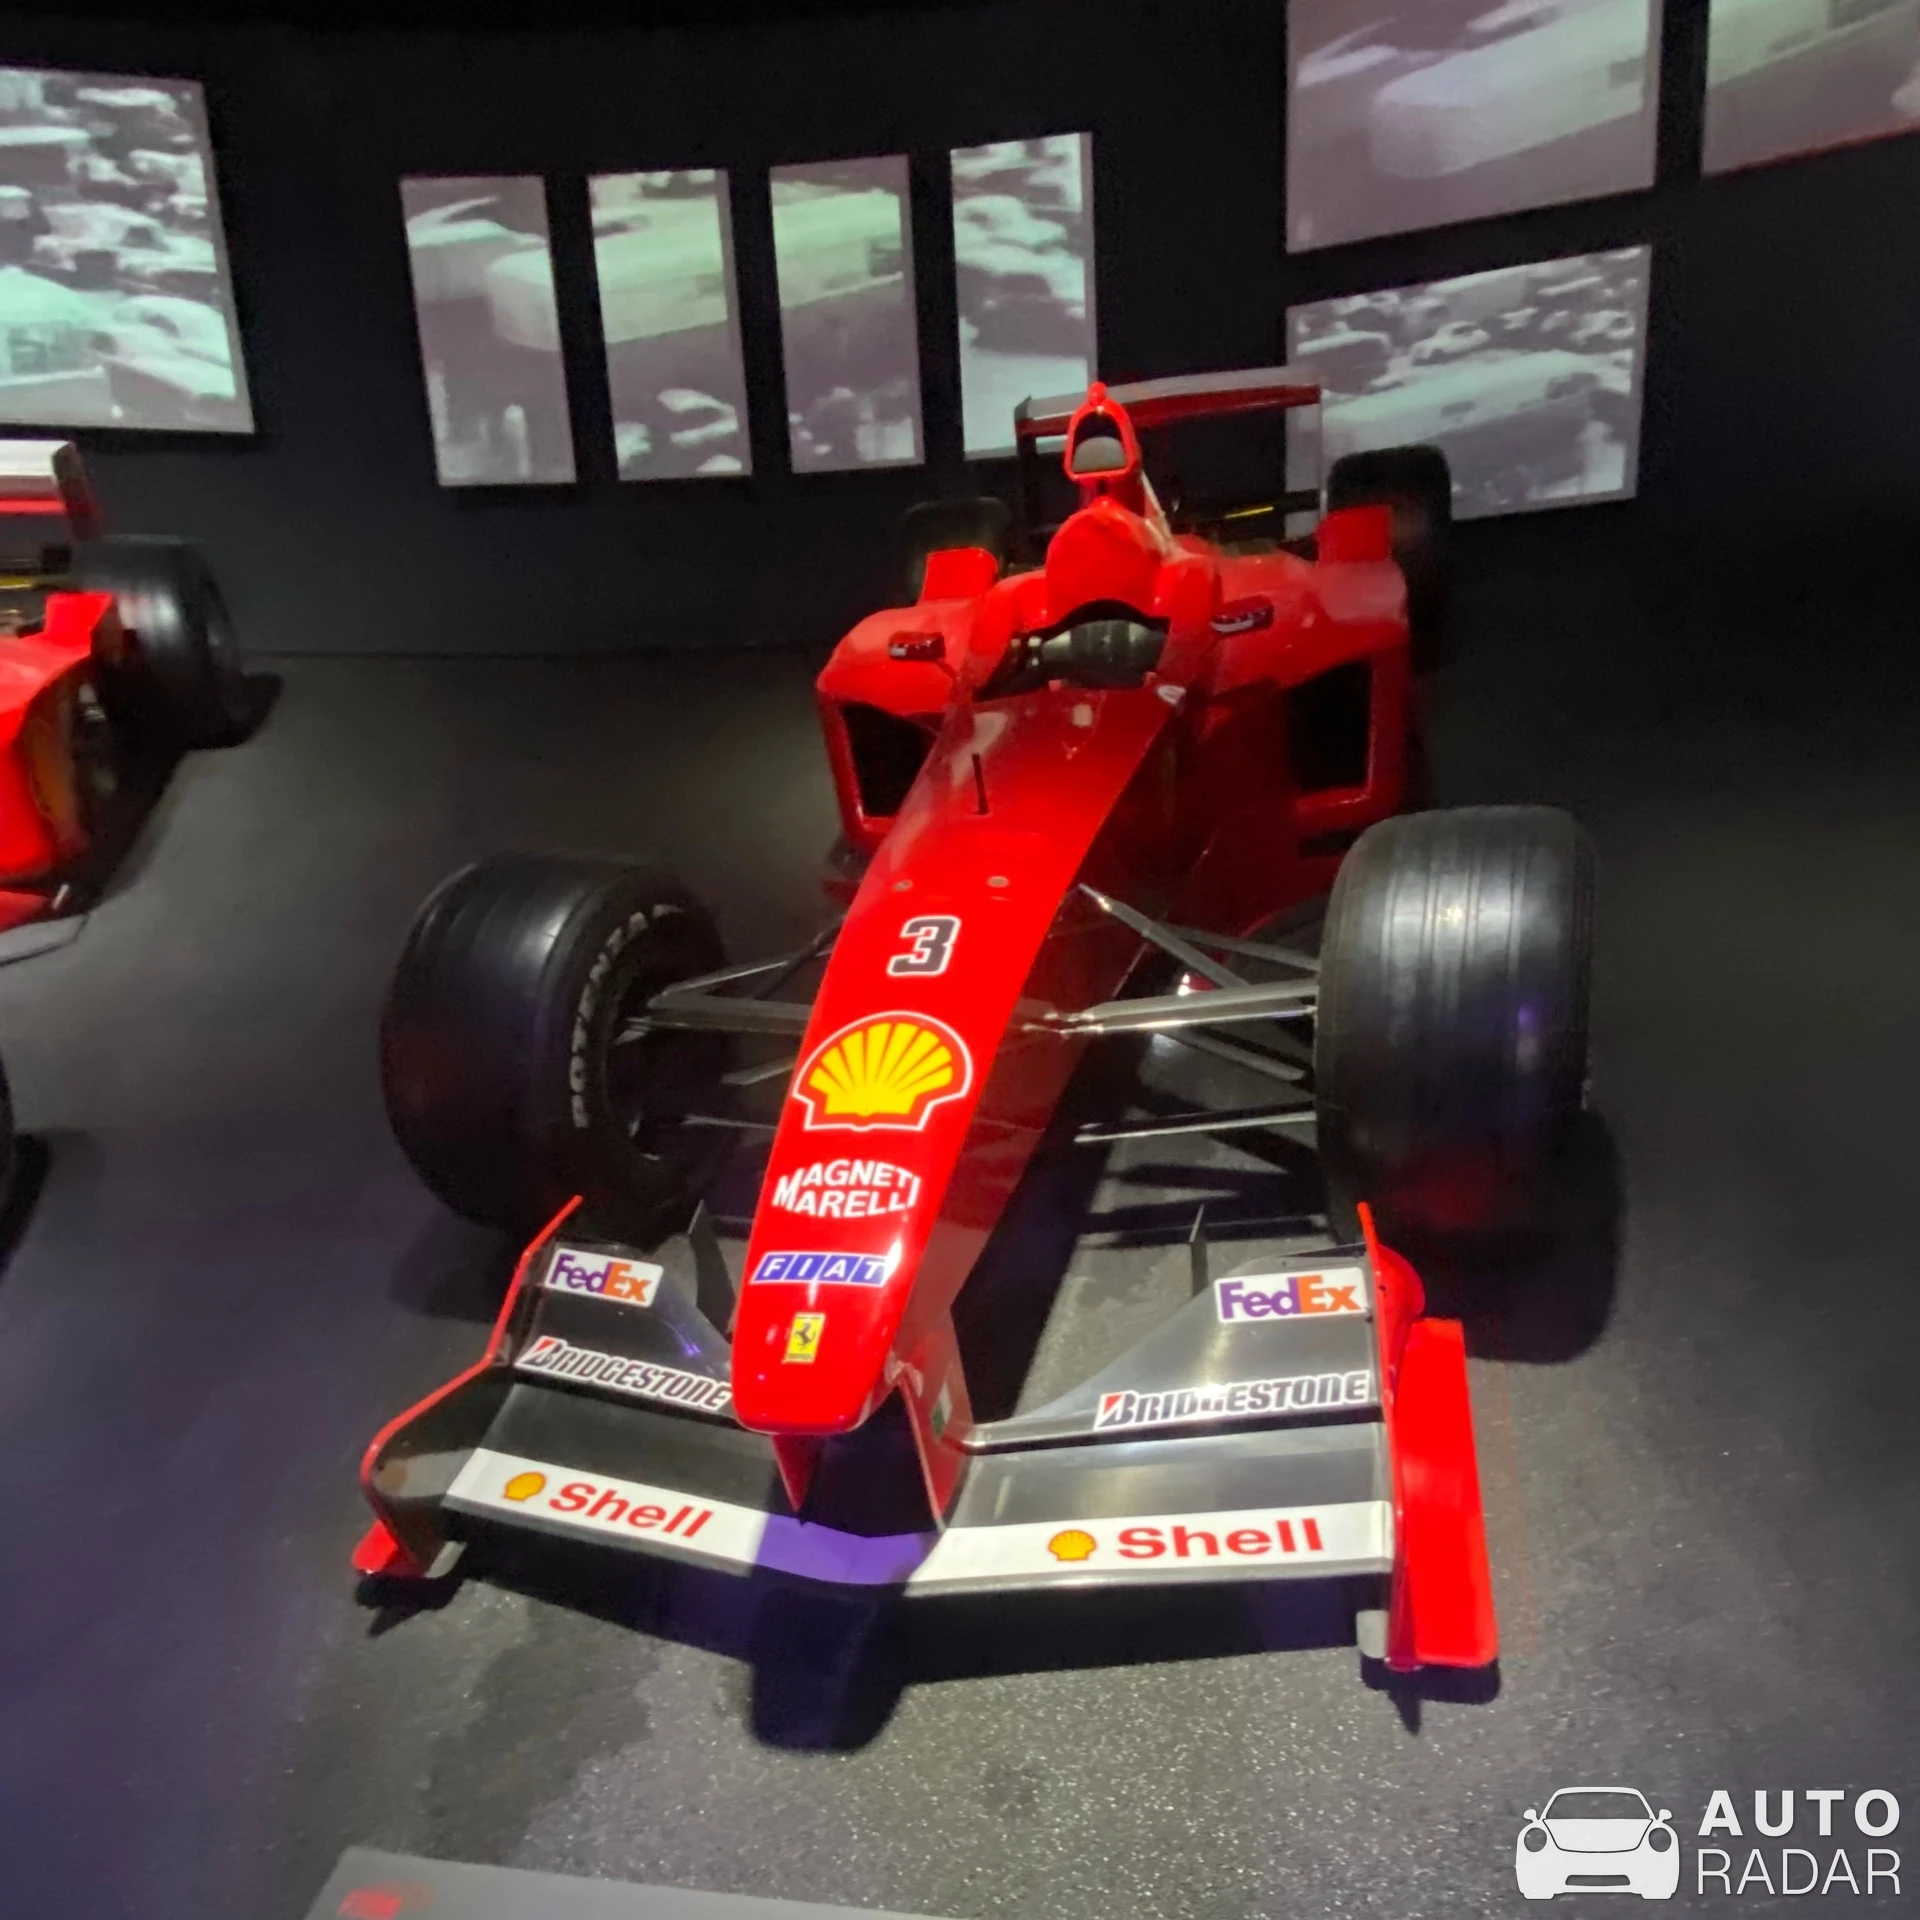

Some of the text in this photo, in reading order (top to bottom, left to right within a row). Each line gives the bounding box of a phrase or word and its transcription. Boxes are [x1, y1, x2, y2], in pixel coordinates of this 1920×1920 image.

[886, 915, 962, 977] 3
[772, 1159, 921, 1203] MAGNETI
[772, 1174, 921, 1218] MARELLI
[551, 1254, 652, 1302] FedEx
[763, 1257, 888, 1280] FIAT
[1219, 1275, 1364, 1320] FedEx
[516, 1337, 732, 1410] BRIDGESTONE
[1095, 1371, 1369, 1430] BRIDGESTONE
[548, 1482, 713, 1538] Shell
[1117, 1518, 1324, 1559] Shell
